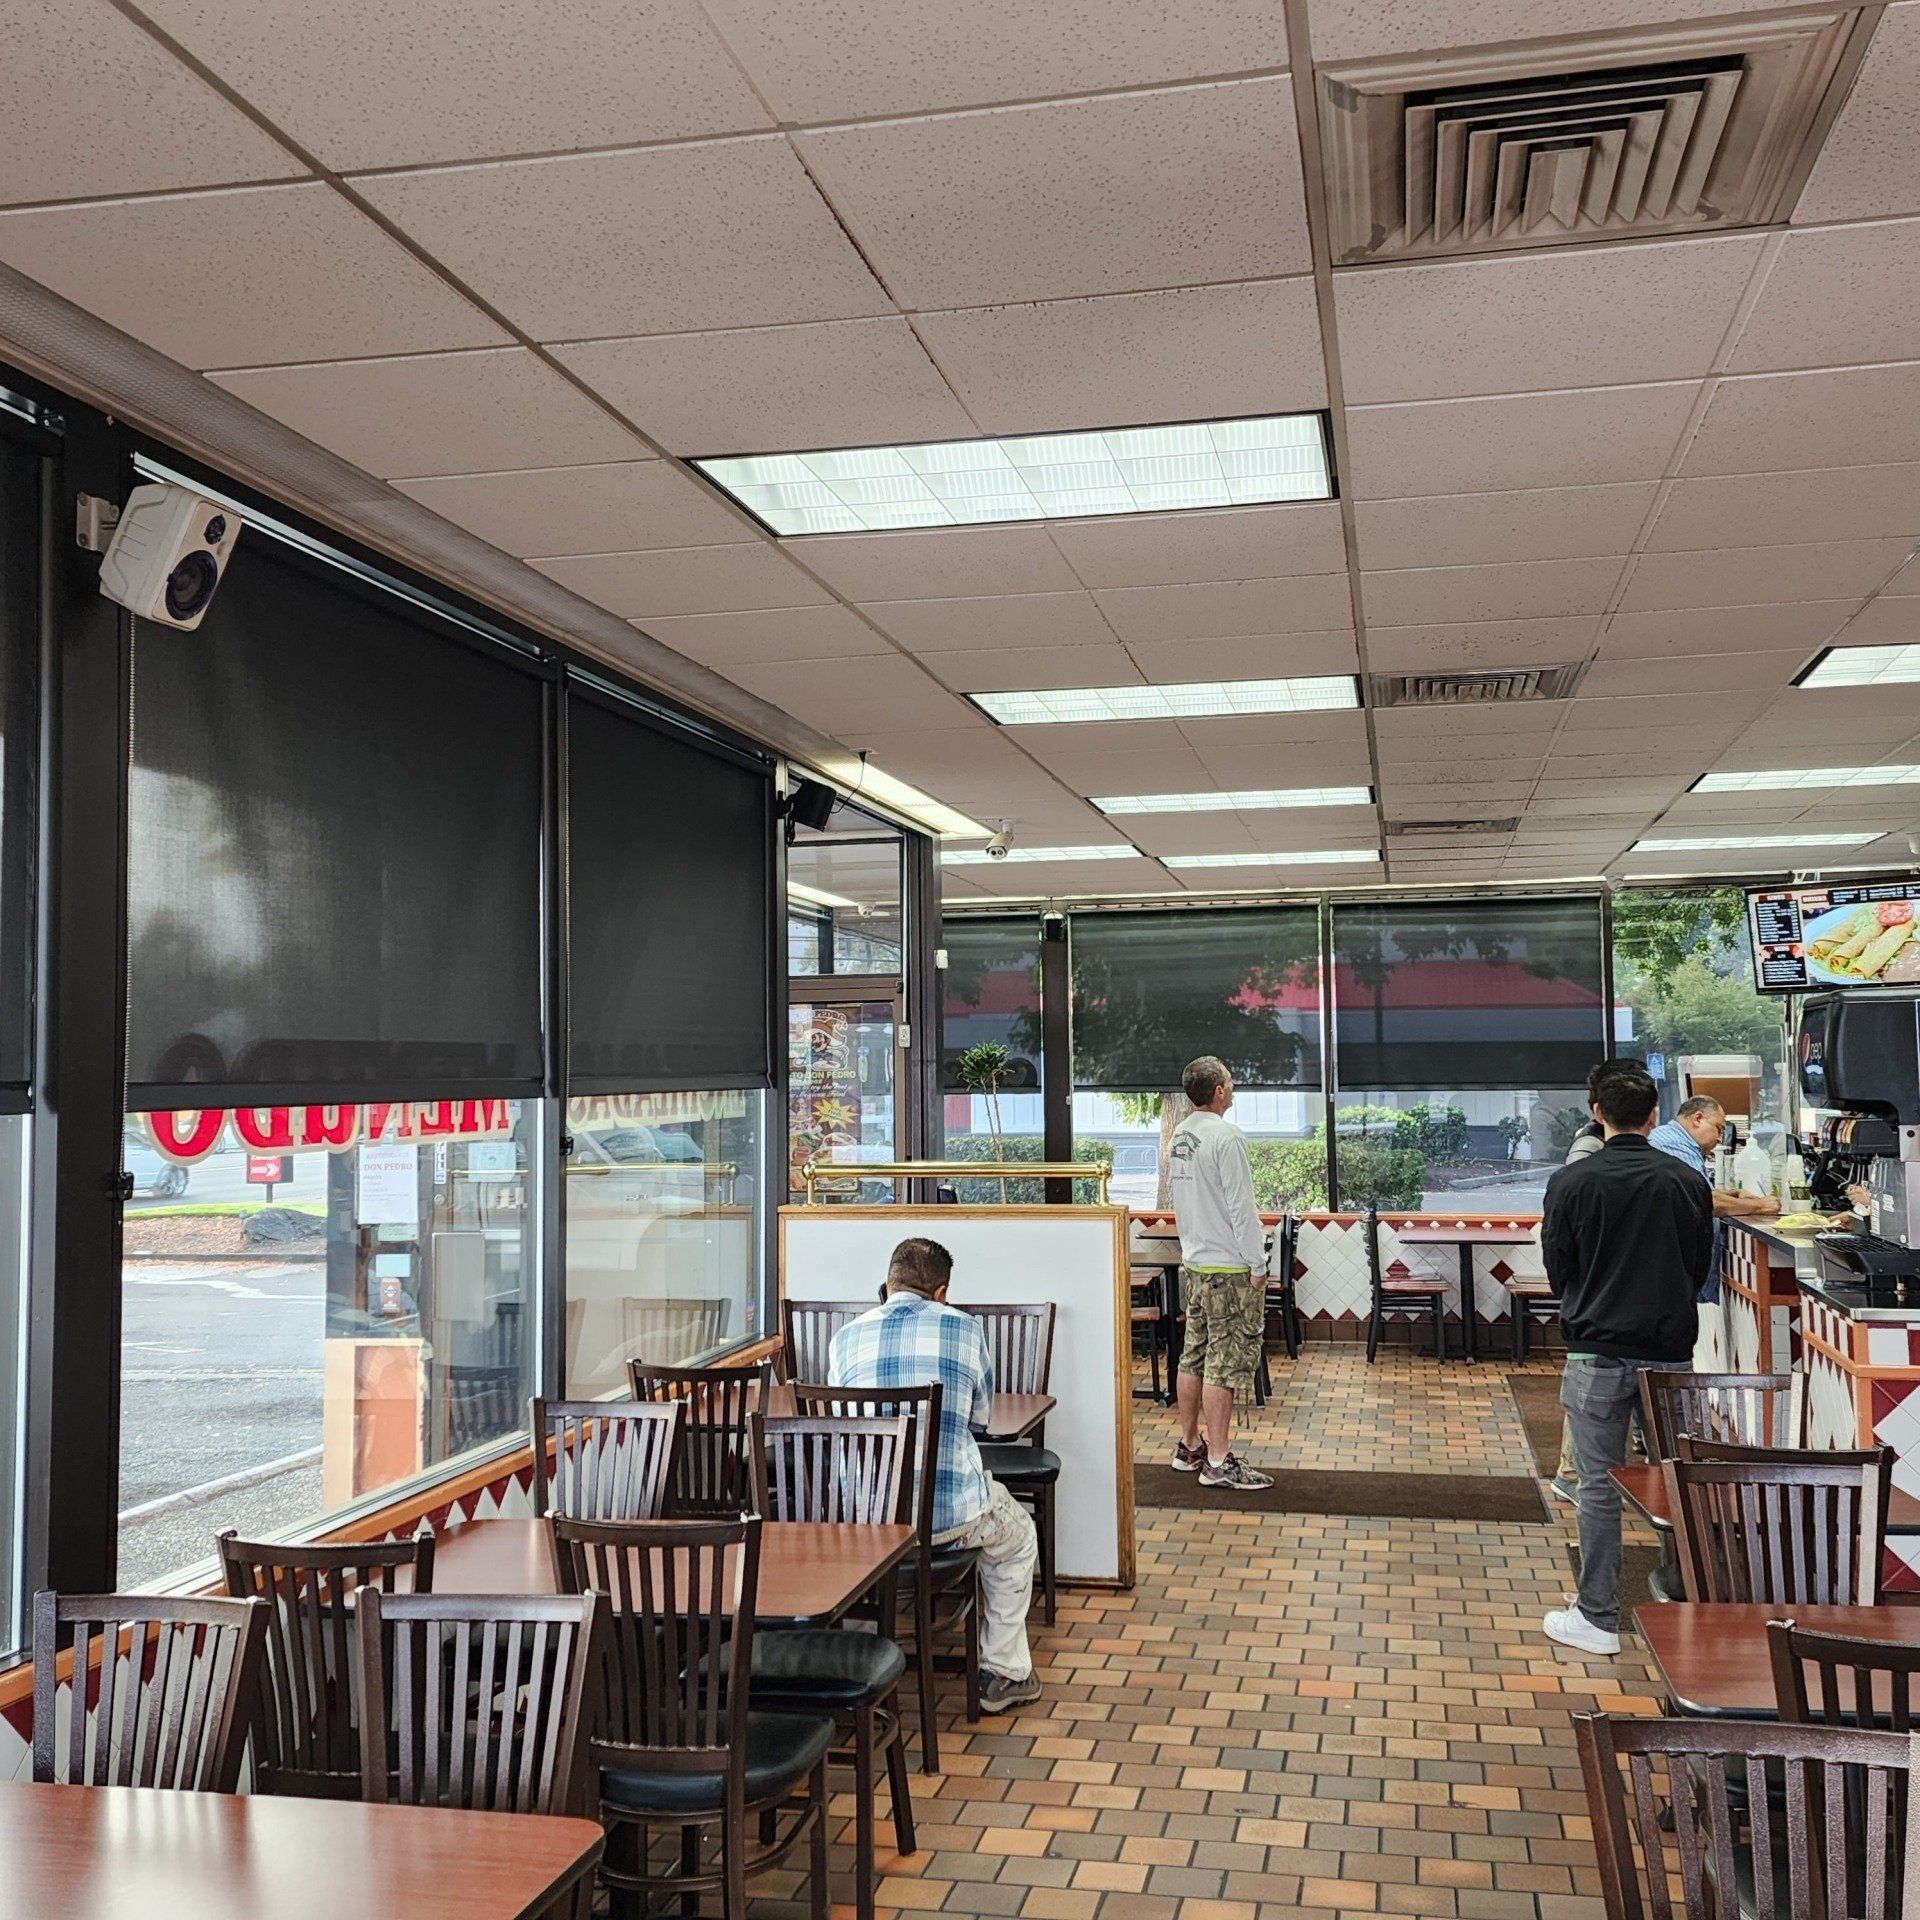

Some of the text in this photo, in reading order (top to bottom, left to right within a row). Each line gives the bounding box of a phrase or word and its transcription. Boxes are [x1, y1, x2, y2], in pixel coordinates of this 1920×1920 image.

[826, 1070, 856, 1079] PEDRO
[364, 1162, 413, 1172] DON PEDRO
